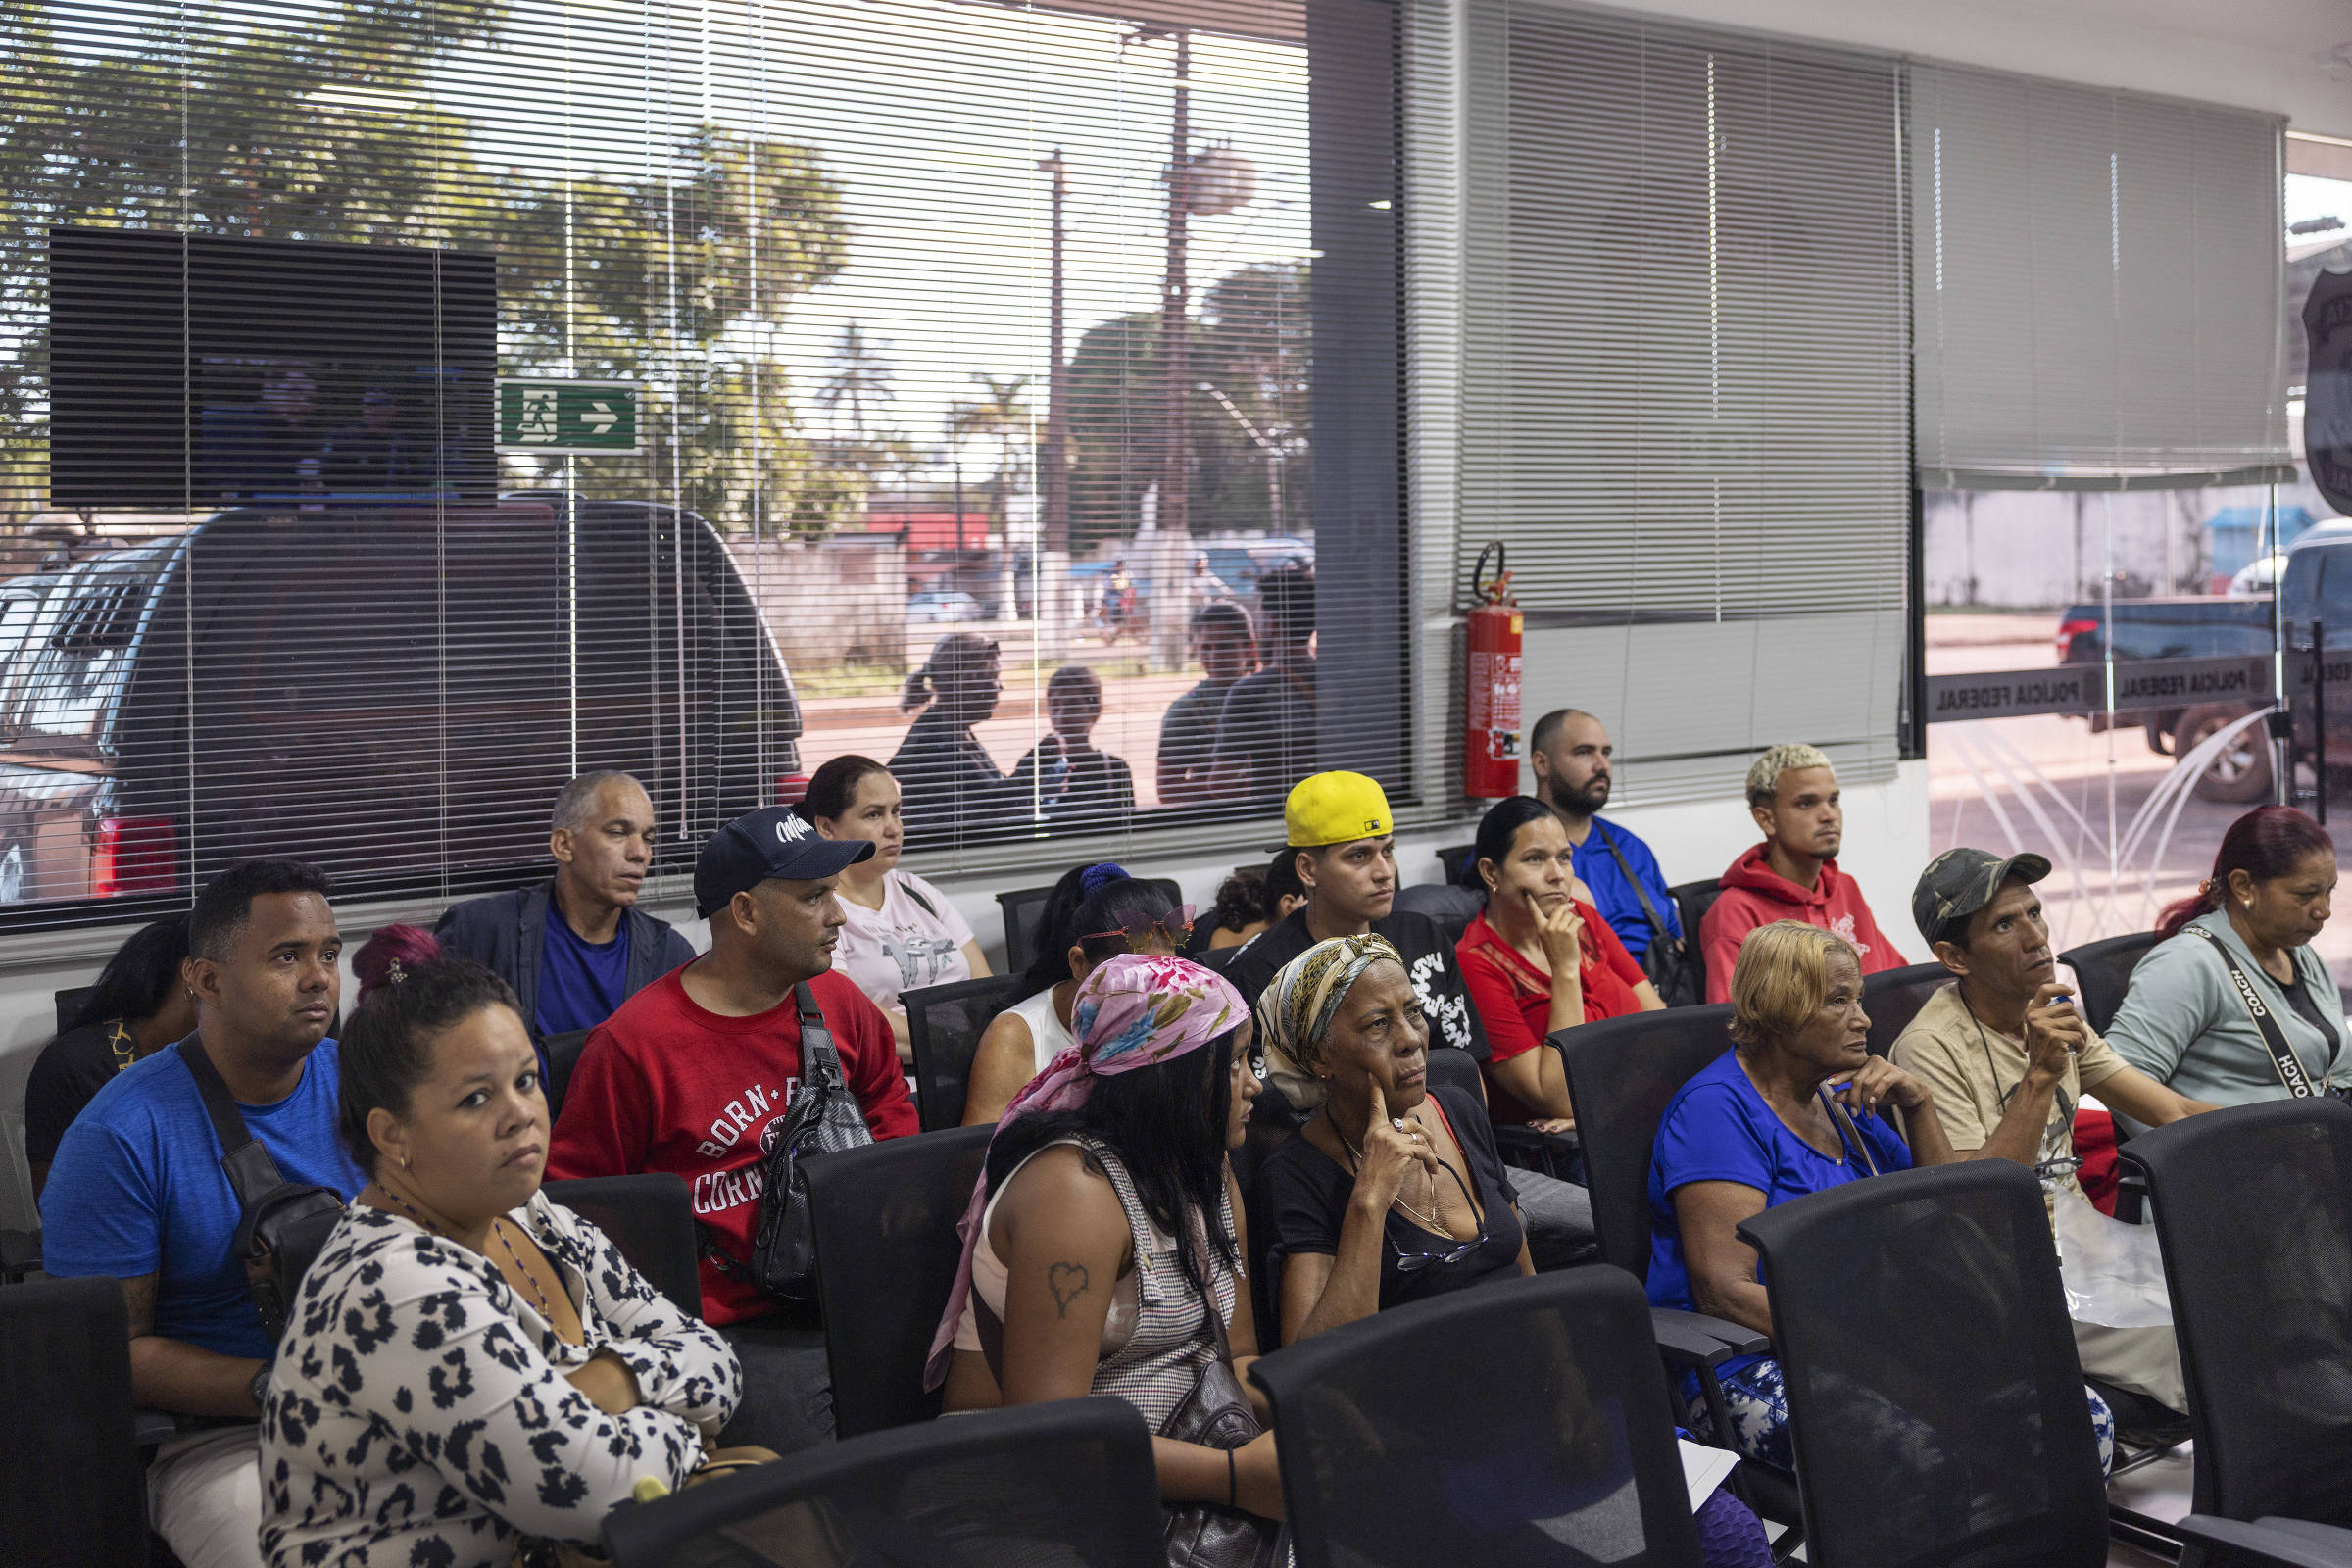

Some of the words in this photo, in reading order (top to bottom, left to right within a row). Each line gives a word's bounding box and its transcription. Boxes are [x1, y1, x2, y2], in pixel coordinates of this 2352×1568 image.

[2231, 969, 2266, 1016] COACH
[2278, 1054, 2308, 1098] OACH
[695, 1083, 770, 1159] BORN
